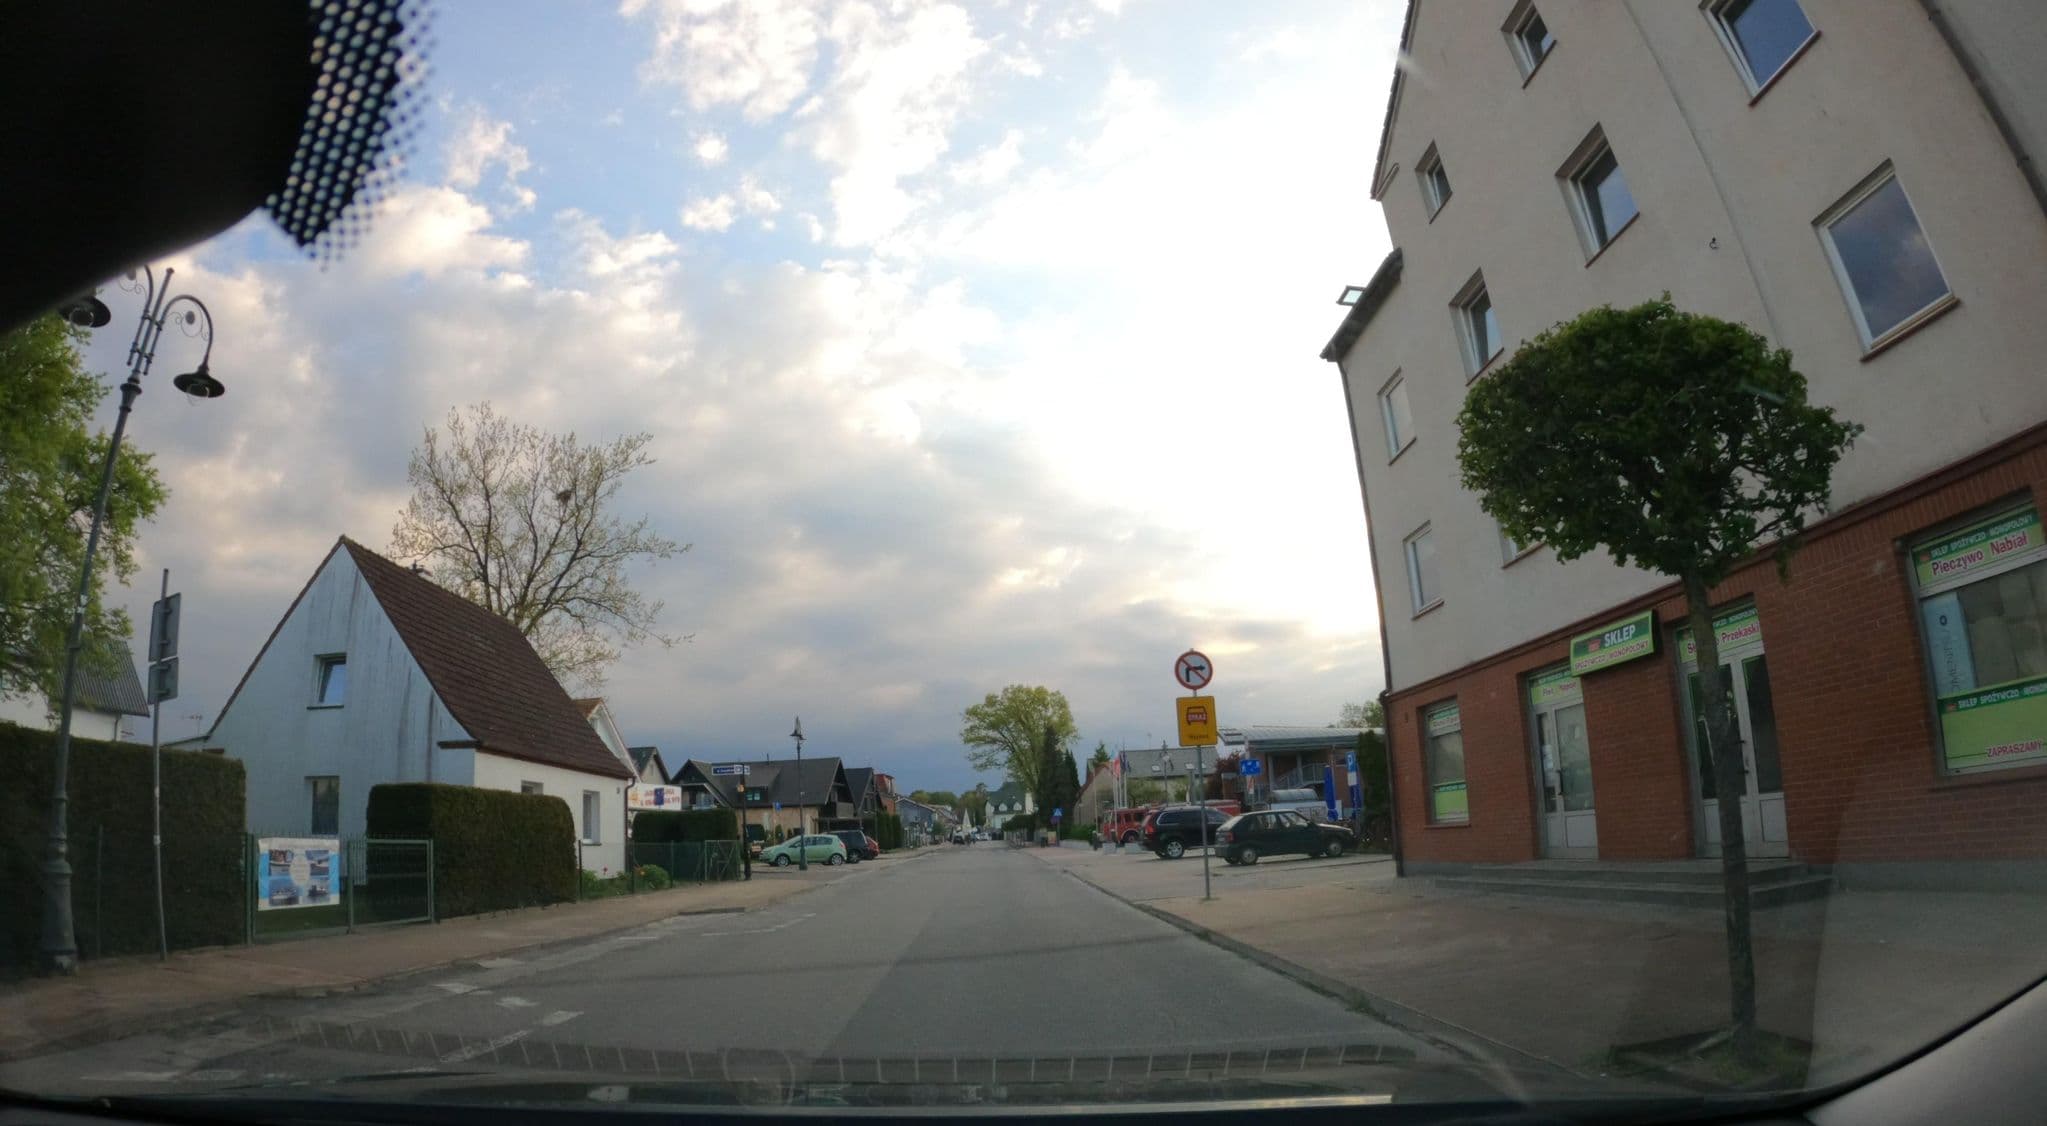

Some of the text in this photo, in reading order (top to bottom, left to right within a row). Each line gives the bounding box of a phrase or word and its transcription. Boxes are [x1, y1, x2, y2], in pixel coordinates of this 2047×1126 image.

[1932, 531, 2028, 576] Pieczywo Nabiał
[1604, 624, 1636, 647] SKLEP
[1987, 740, 2043, 758] ZAPRASZAMY
